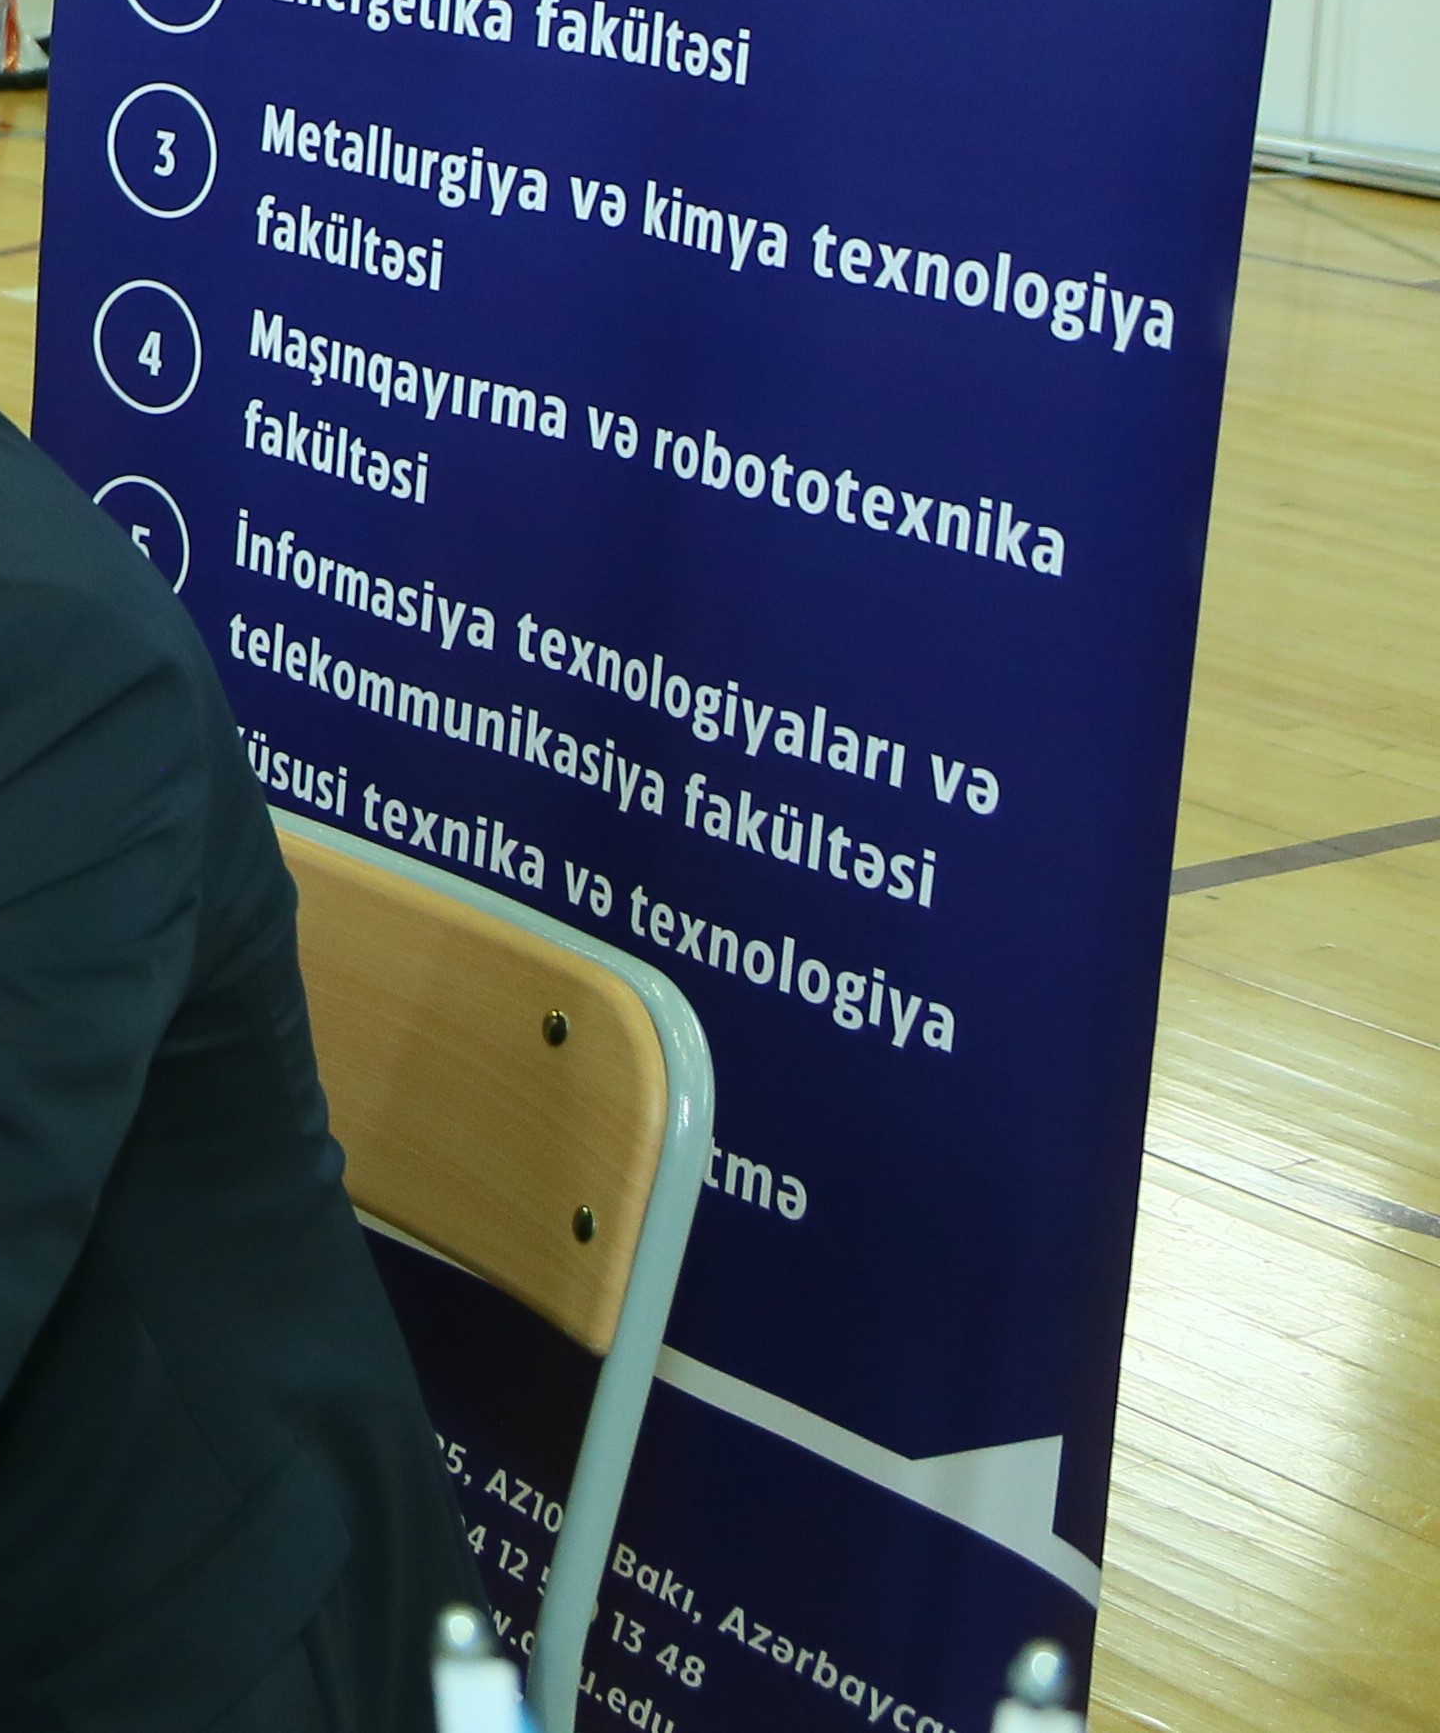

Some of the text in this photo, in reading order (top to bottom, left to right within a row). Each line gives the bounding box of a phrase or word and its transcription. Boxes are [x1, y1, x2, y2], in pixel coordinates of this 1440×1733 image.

[154, 104, 1177, 355] 3 Metallurgiya və kimya texnologiya
[254, 195, 444, 292] fakültəsi
[137, 309, 1066, 578] 4 Maşınqayırma və robototexnika
[243, 399, 430, 506] fakültəsi
[229, 612, 937, 909] telekommunikasiya fakültəsi
[234, 509, 496, 652] İnformasiya
[516, 610, 905, 790] texnologiyaları
[929, 754, 1001, 816] və
[237, 725, 956, 1055] üsusi texnika və texnologiya
[484, 1469, 564, 1532] AZ10
[612, 1543, 701, 1624] Bakı,
[718, 1606, 957, 1733] Azərbayca
[498, 1539, 529, 1581] 12
[612, 1611, 646, 1653] 13
[656, 1643, 705, 1688] 48
